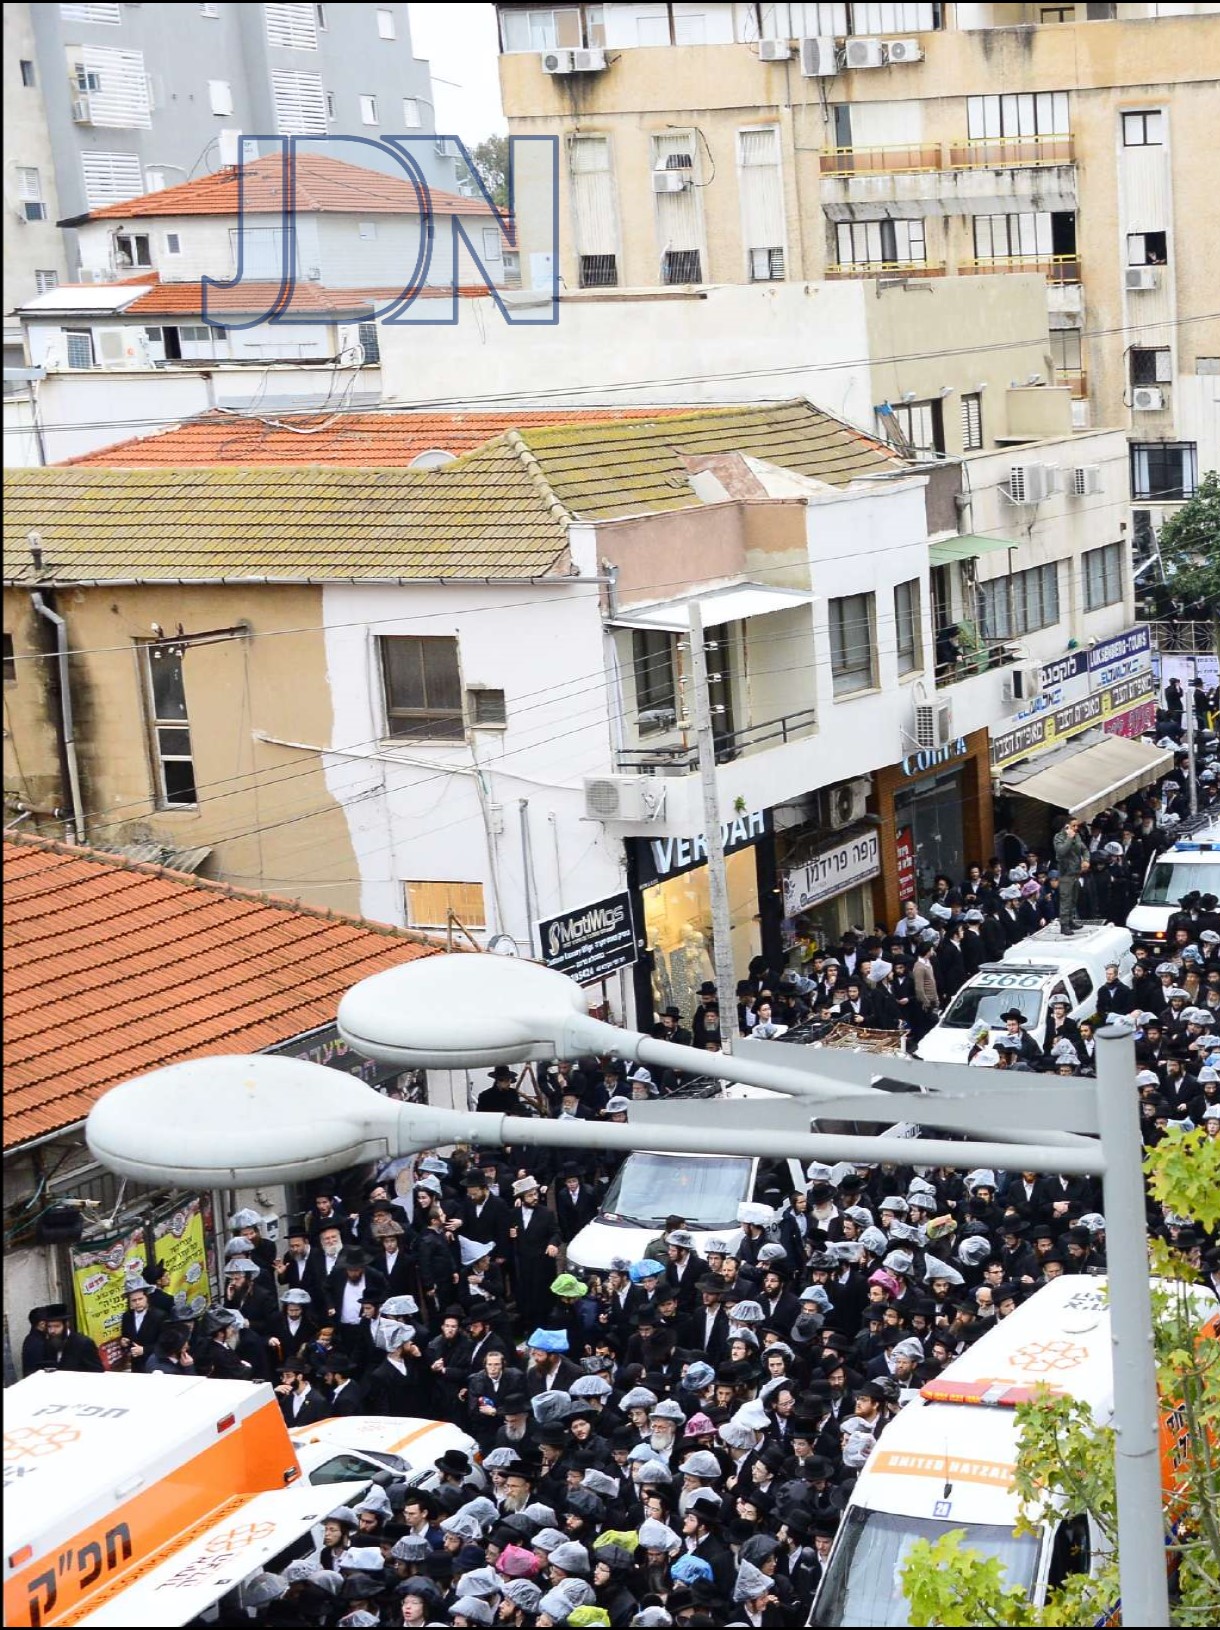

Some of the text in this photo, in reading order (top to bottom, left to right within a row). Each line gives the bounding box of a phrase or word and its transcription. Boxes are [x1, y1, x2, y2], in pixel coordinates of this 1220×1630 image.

[852, 836, 878, 866] קפה
[805, 853, 848, 893] פרידמן
[888, 1455, 945, 1472] UNITED
